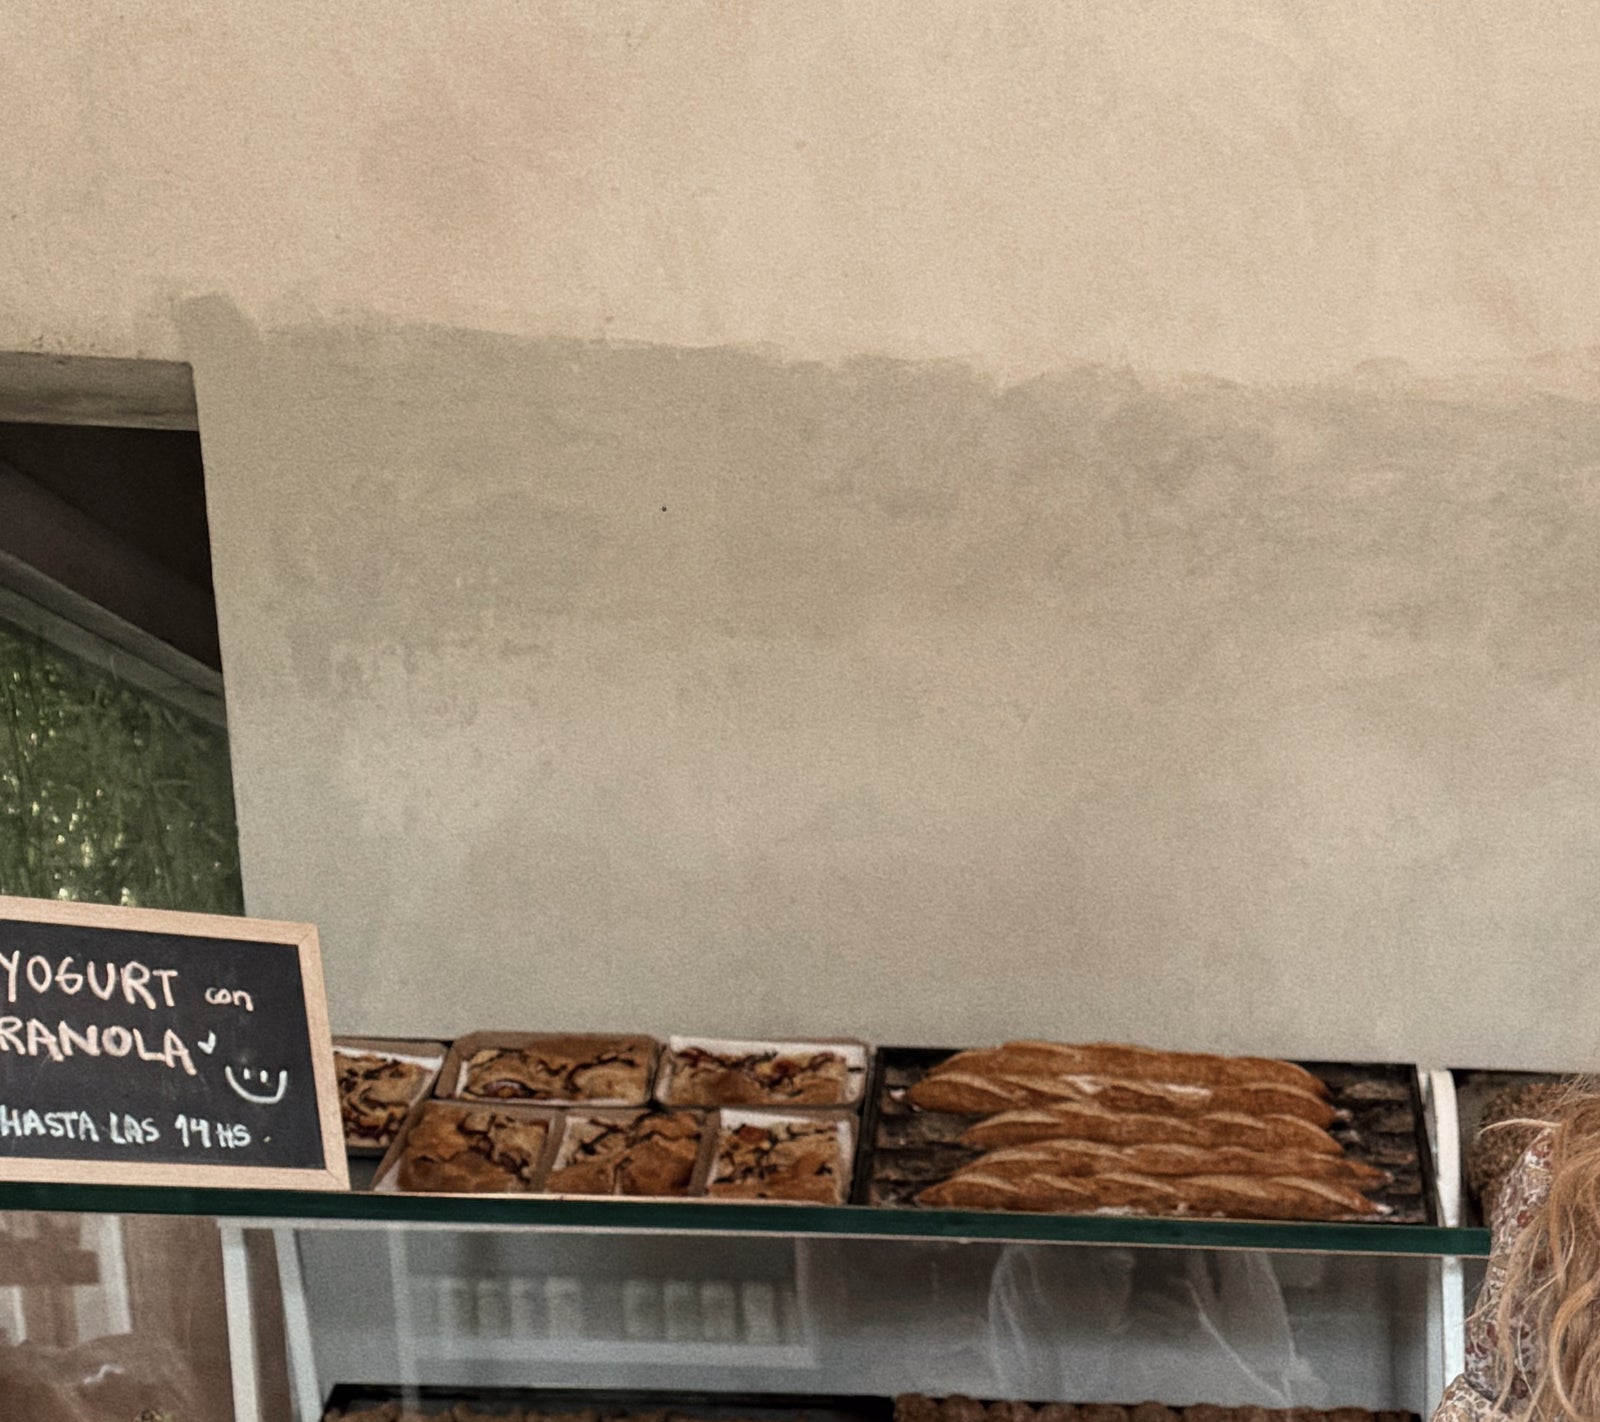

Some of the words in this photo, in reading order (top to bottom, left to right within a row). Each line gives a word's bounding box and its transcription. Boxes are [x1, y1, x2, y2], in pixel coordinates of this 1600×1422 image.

[0, 951, 178, 1009] YOGURT
[205, 988, 254, 1011] con
[0, 1016, 197, 1075] RANOLA
[0, 1105, 99, 1142] HASTA
[110, 1112, 160, 1144] LAS
